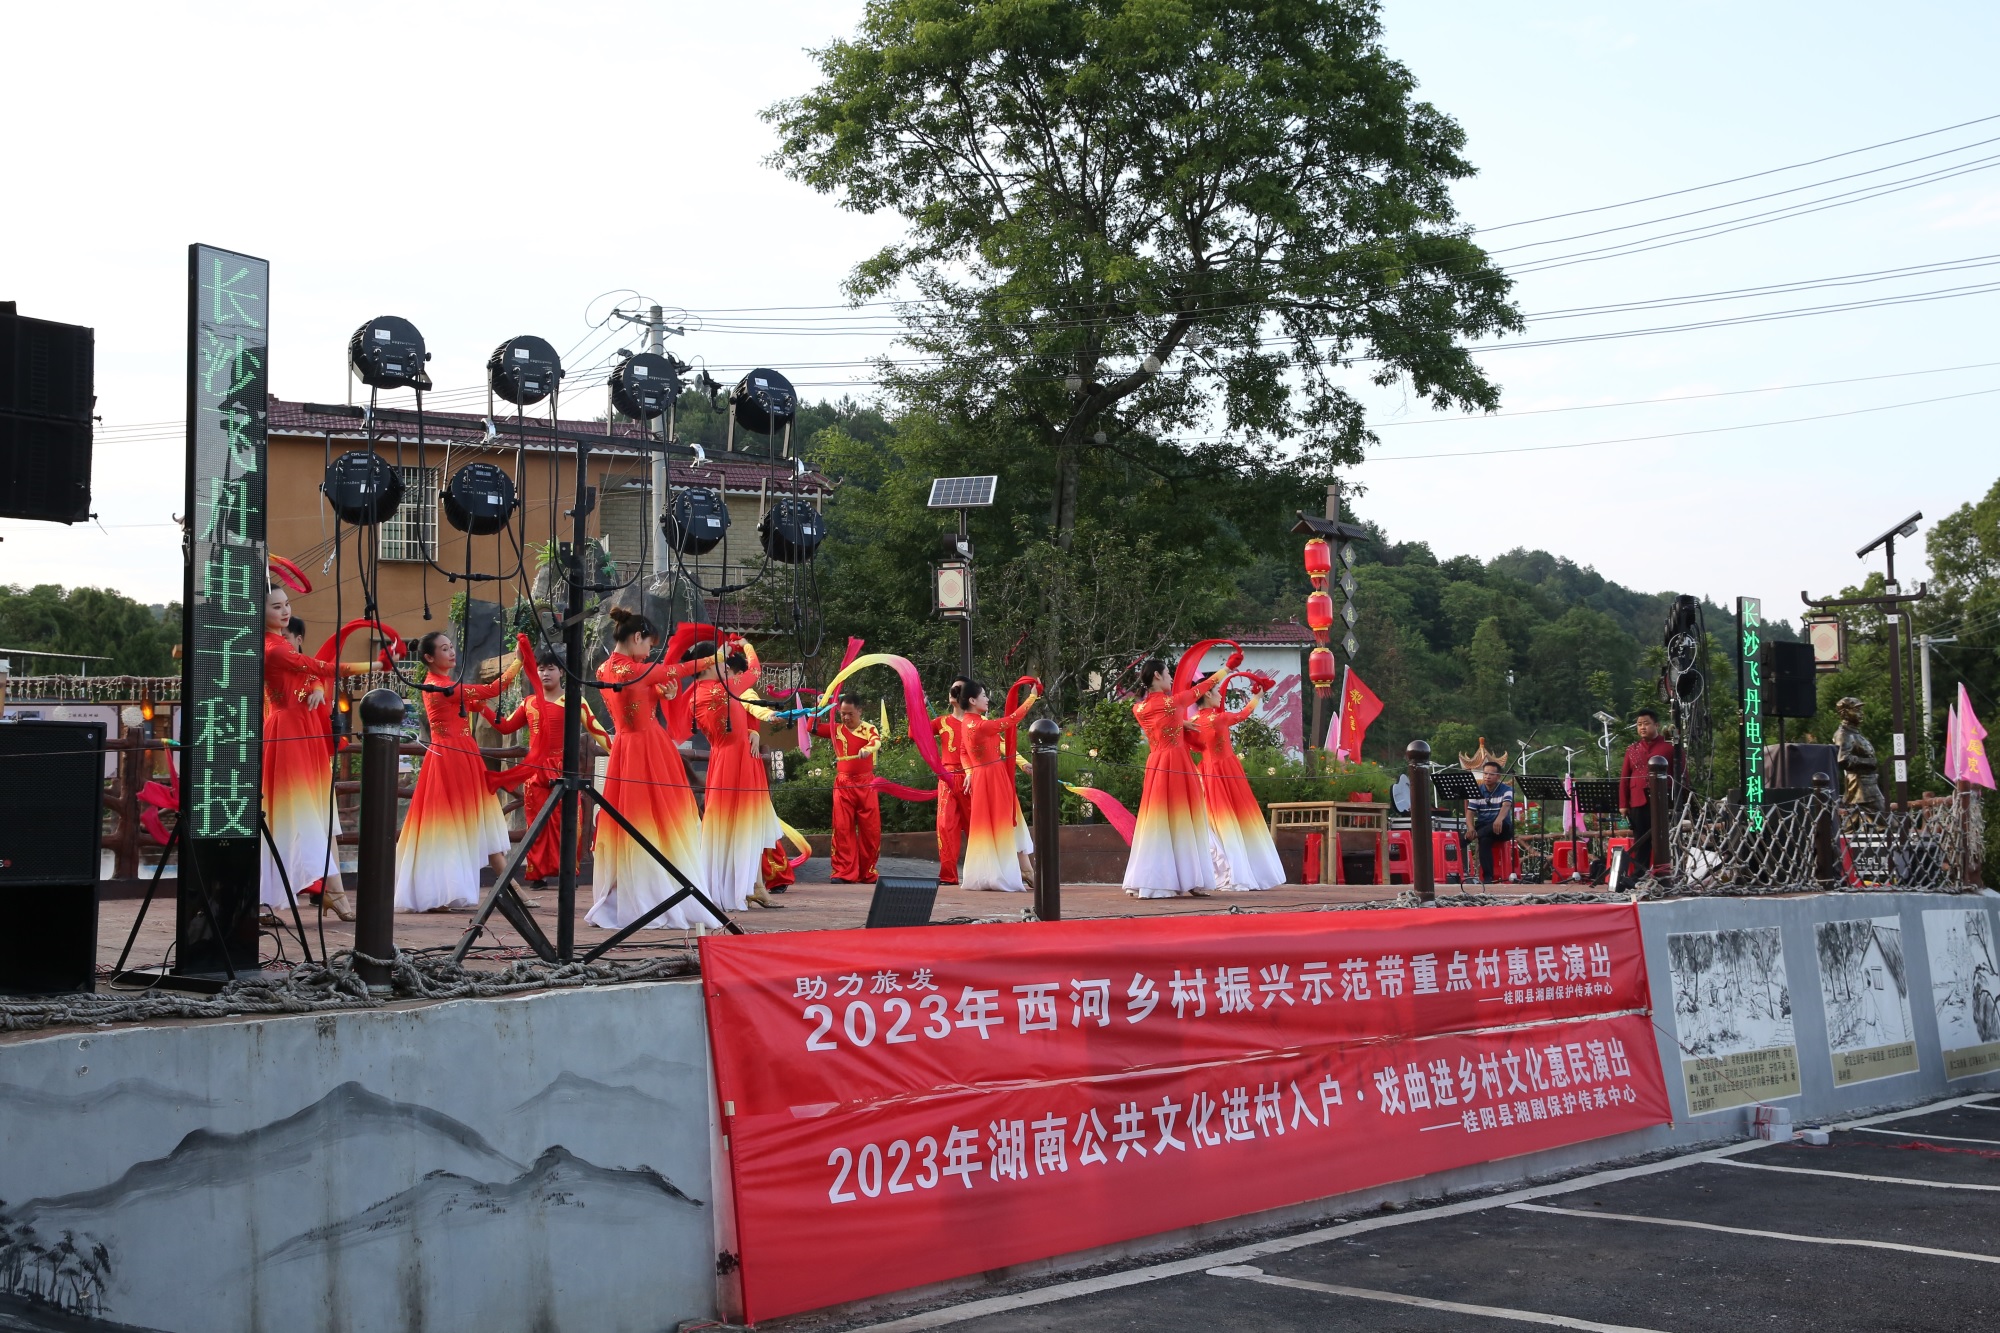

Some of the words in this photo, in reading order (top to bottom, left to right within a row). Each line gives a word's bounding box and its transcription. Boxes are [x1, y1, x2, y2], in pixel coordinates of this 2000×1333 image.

[193, 258, 260, 836] 长沙飞丹电子科技
[793, 967, 939, 1000] 助力旅发
[803, 943, 1611, 1052] 2023年西河乡村振兴示范带重点村惠民演出
